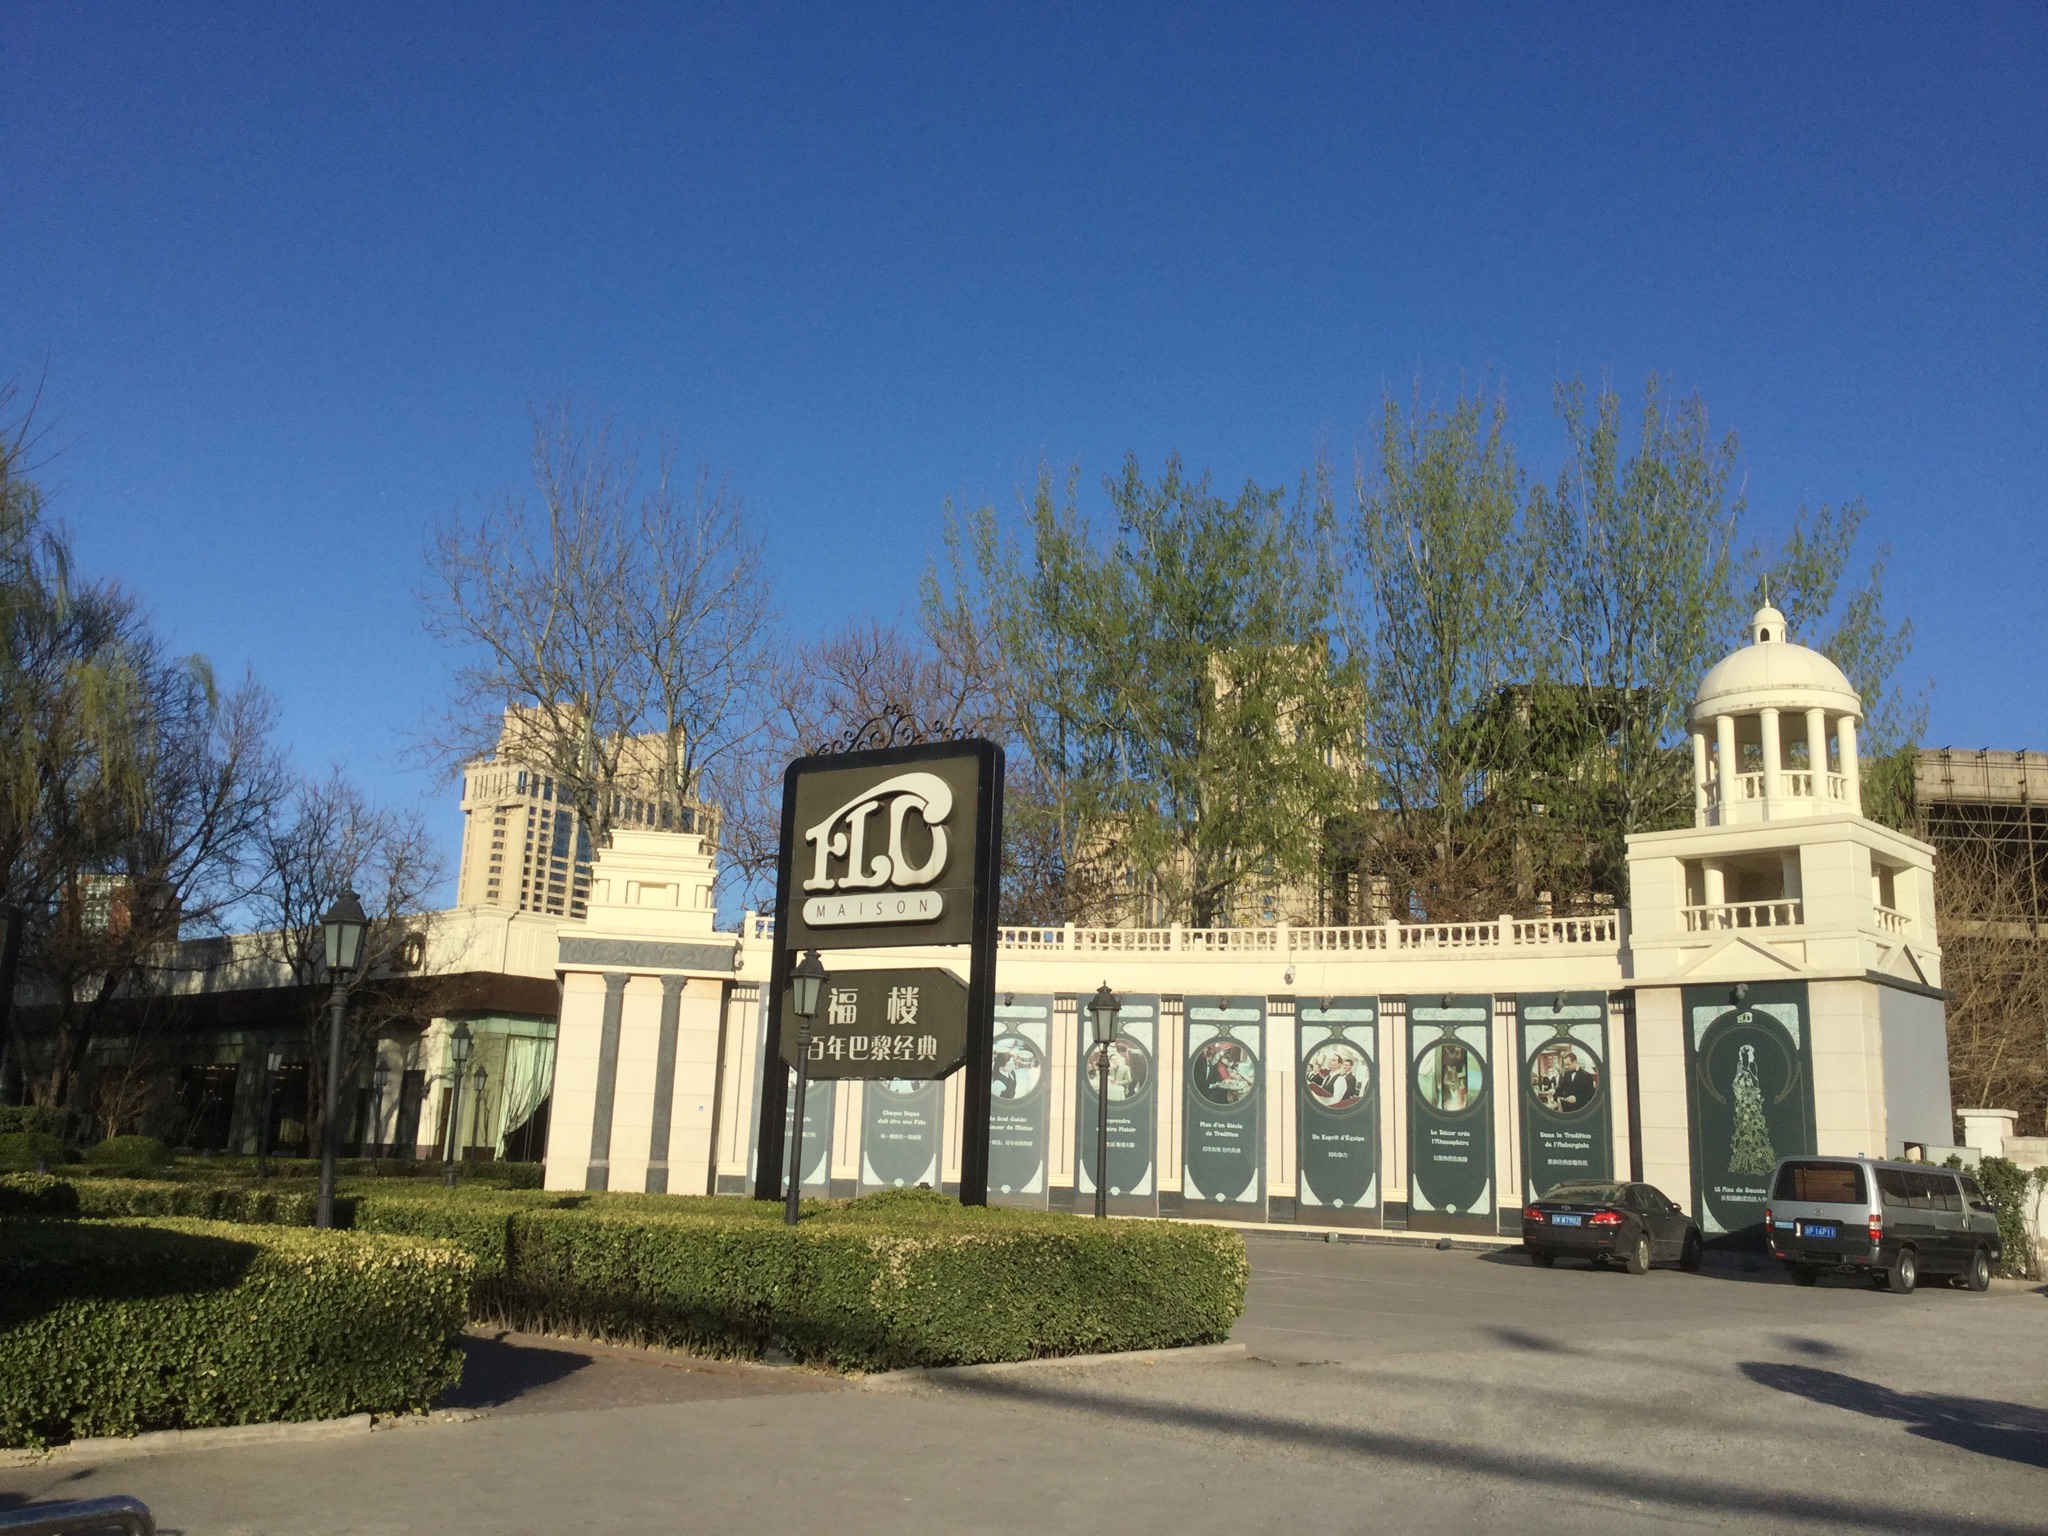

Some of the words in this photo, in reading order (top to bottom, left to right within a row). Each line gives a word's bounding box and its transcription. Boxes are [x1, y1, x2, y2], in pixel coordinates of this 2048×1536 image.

[803, 772, 953, 890] FLO
[816, 899, 928, 917] MAISON
[807, 1035, 937, 1061] 百年巴黎经典
